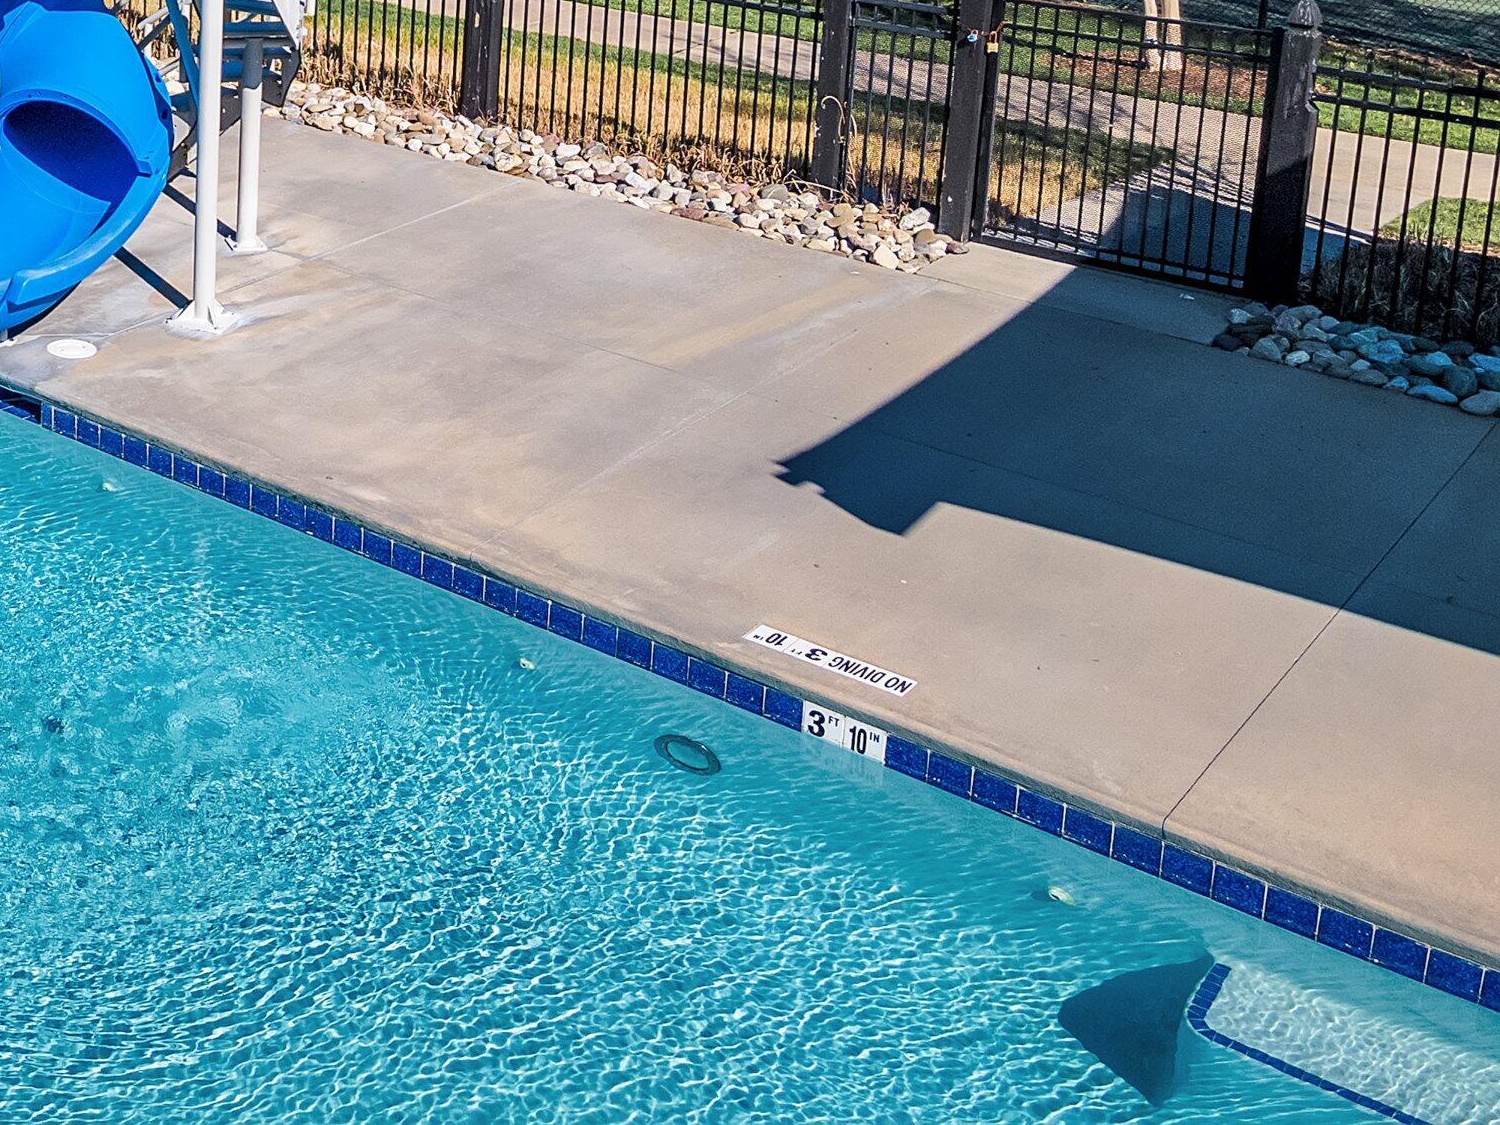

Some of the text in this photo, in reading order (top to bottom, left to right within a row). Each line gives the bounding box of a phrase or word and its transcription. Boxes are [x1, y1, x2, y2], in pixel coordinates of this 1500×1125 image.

[765, 632, 788, 647] 10
[804, 648, 828, 661] 3
[828, 656, 886, 683] DIVING
[884, 677, 912, 693] NO
[807, 710, 880, 755] 3 FT 10 IN
